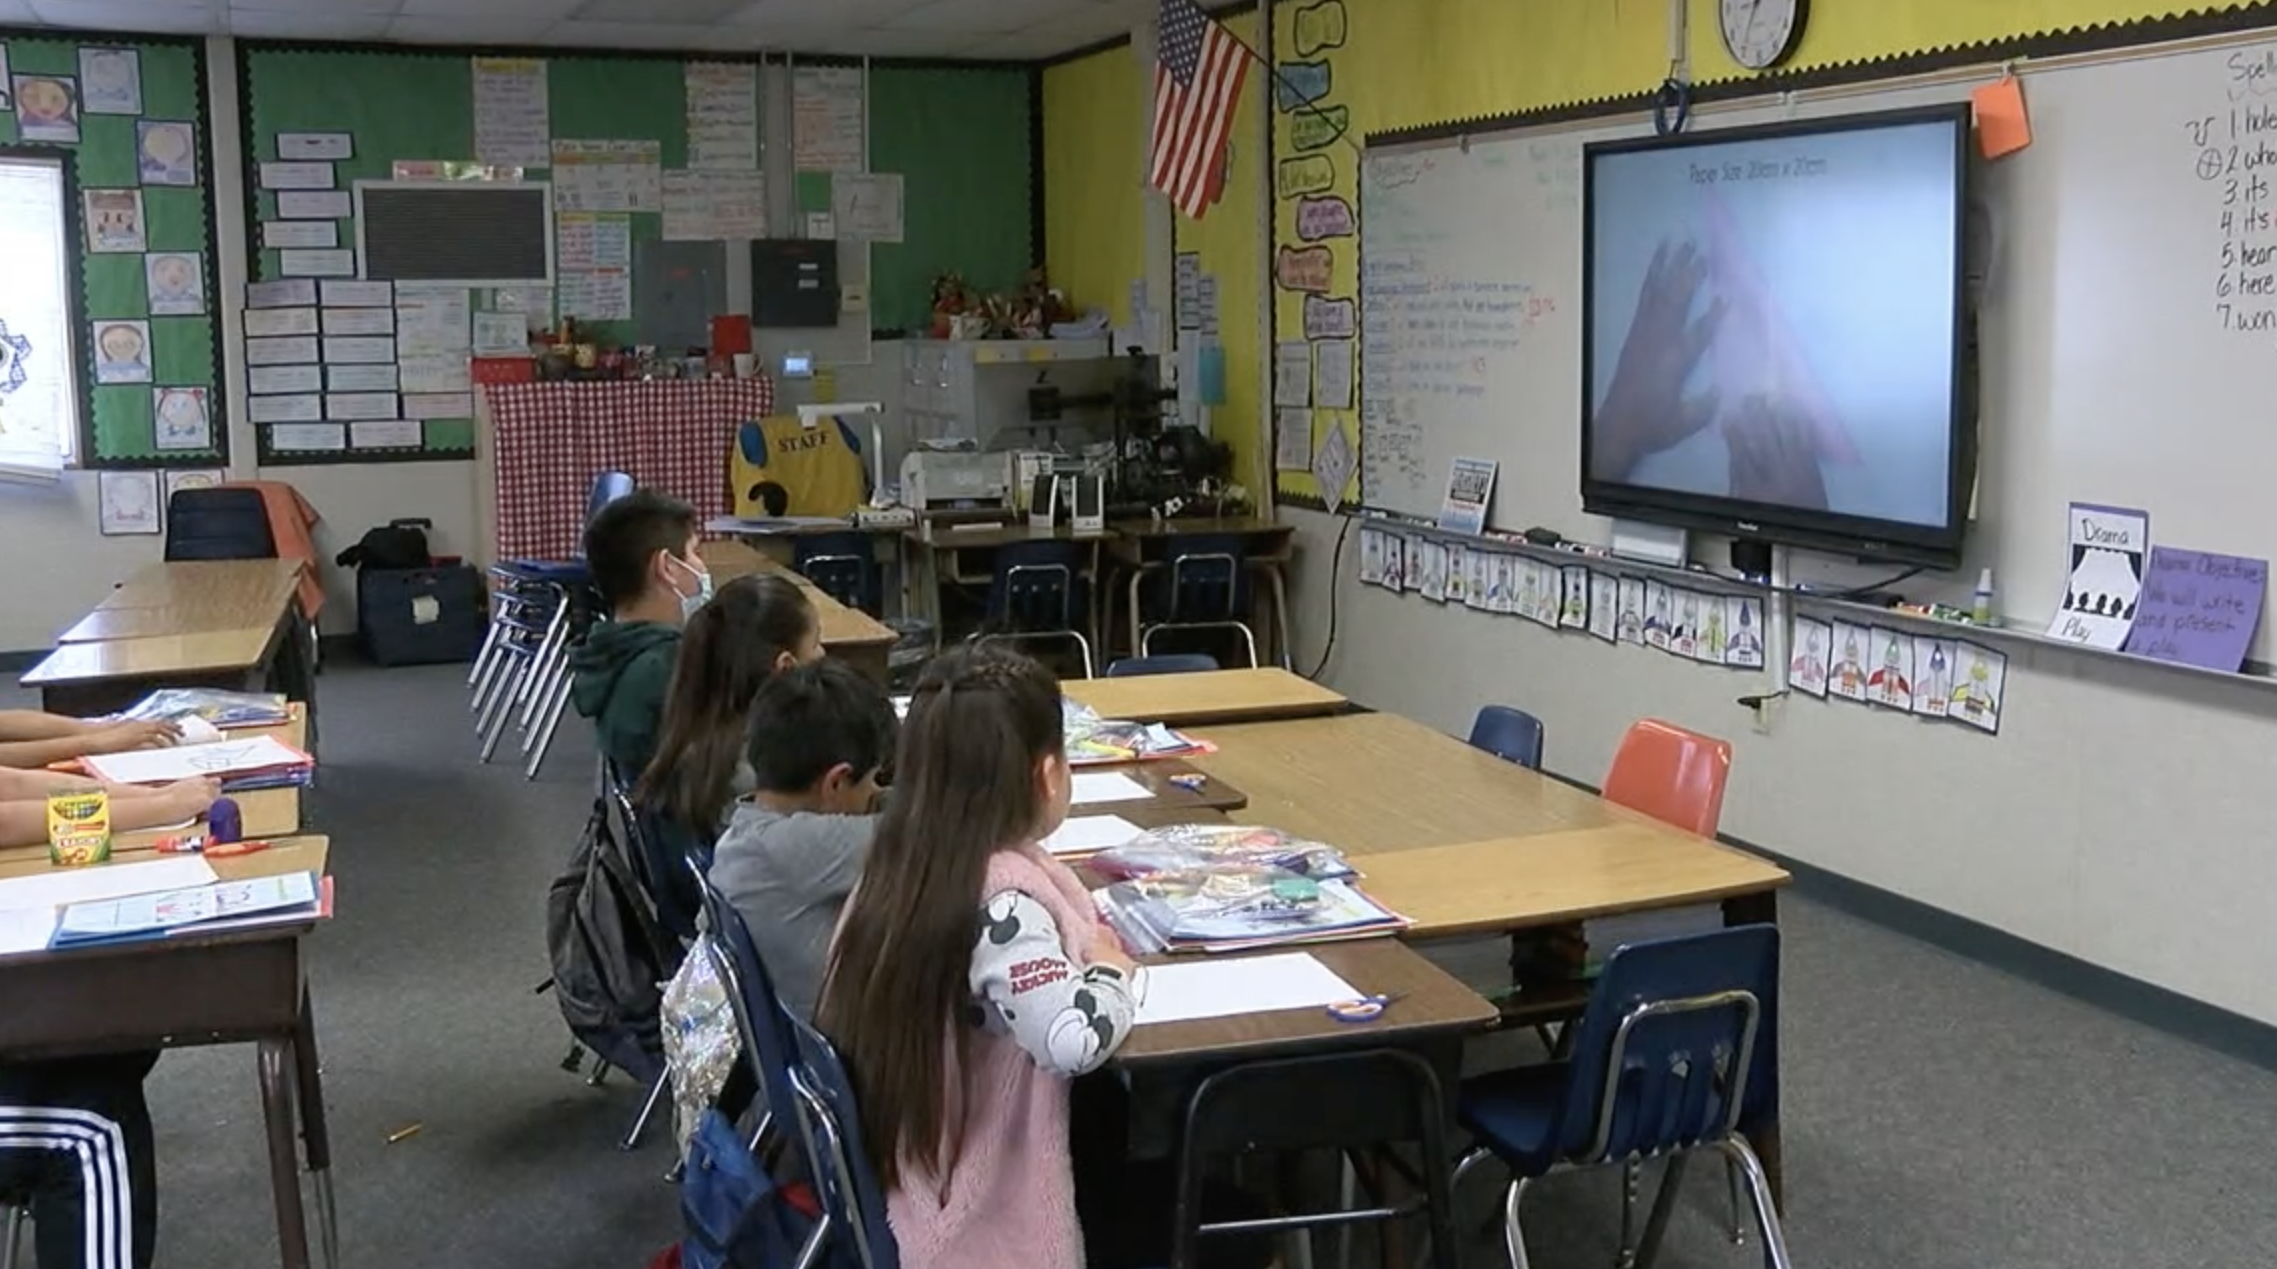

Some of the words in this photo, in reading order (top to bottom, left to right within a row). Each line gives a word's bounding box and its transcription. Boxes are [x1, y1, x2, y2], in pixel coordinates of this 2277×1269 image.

[2227, 51, 2277, 89] Spell
[2244, 173, 2269, 202] its
[2240, 240, 2277, 267] hear
[2239, 271, 2276, 295] here
[778, 430, 830, 453] STAFF
[2082, 518, 2130, 545] Drama
[2062, 617, 2092, 641] Play
